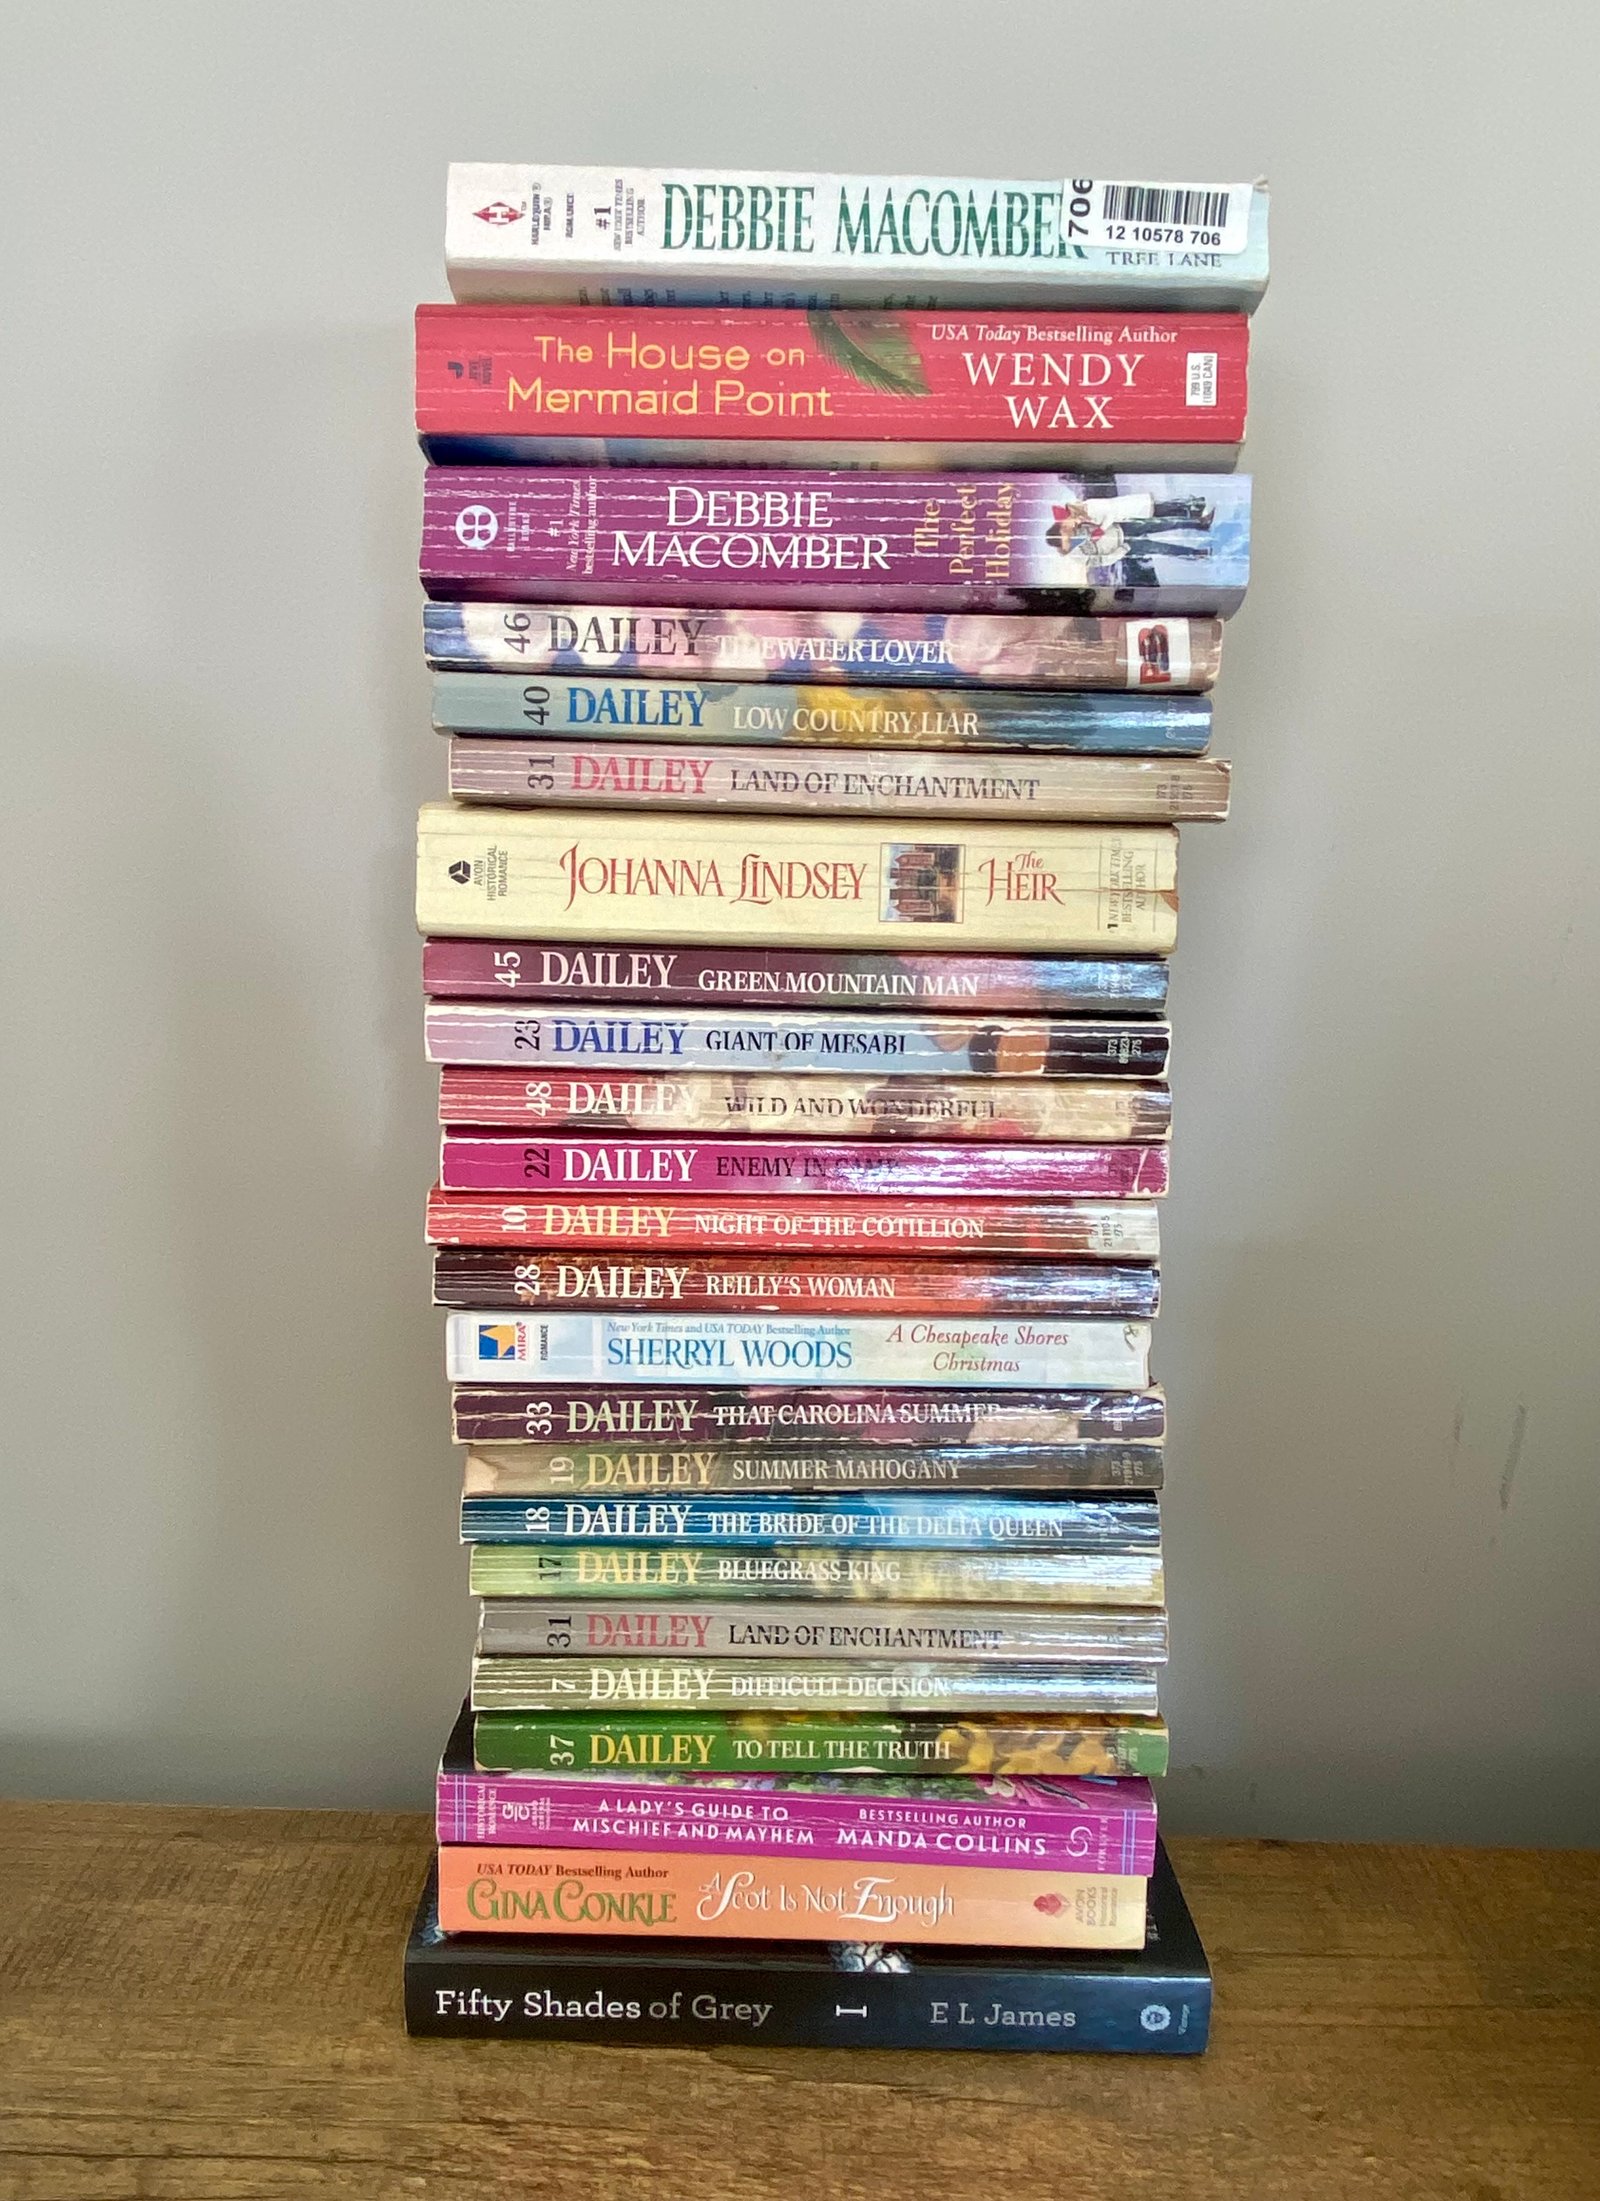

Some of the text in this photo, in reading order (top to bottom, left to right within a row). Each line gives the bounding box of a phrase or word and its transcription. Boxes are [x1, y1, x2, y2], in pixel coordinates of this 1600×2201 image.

[594, 206, 611, 230] #1
[661, 182, 815, 253] DEBBIE
[1066, 179, 1092, 237] 706
[1106, 225, 1221, 247] 12 10578 706
[1106, 251, 1222, 268] TREE LANE
[534, 332, 804, 371] The House on
[931, 324, 1178, 345] USA Today Bestselling Author
[962, 352, 1146, 387] WENDY
[508, 377, 834, 417] Mermaid Point
[1004, 396, 1115, 430] WAX
[666, 486, 834, 528] DEBBIE
[949, 484, 979, 576] Perfect
[985, 482, 1018, 578] Holiday
[611, 531, 892, 571] MACOMBER
[504, 613, 953, 665] 46 DAILEY LOVER
[523, 686, 979, 737] 40 DAILEY LOW COUNTRY LIAR
[528, 754, 1040, 801] 31 DAILEY LAND OF ENCHANTMENT
[474, 860, 483, 886] AVON
[487, 845, 497, 901] HISTORICAL
[498, 851, 508, 897] ROMANCE
[559, 841, 868, 912] JOHANNA LINDSEY
[1016, 850, 1044, 872] The
[978, 859, 1066, 907] HEIR
[494, 950, 980, 997] 45 DAILEY GREEN MOUNTAIN MAN
[513, 1019, 906, 1056] 23 DAILEY GIANT OF MESABI
[525, 1081, 842, 1118] 48 DAILEY WILD AND
[523, 1148, 550, 1179] 22
[562, 1148, 698, 1183] DAILEY
[716, 1156, 795, 1178] ENEMY
[803, 1157, 827, 1178] IN
[502, 1204, 985, 1239] 10 DAILEY NIGHT OF THE COTILLION
[514, 1264, 896, 1299] 28 DAILEY REILLY'S WOMAN
[607, 1321, 851, 1338] New York Times and USA TODAY Bestselling Author
[886, 1324, 1069, 1348] A Chesapeake Shores
[607, 1338, 853, 1371] SHERRYL WOODS
[933, 1352, 1021, 1373] Christmas
[526, 1400, 1001, 1435] 33 DAILEY THAT CAROLINA SUMMER
[550, 1452, 961, 1486] 19 DAILEY SUMMER MAHOGANY
[525, 1503, 1064, 1538] 18 DAILEY THE BRIDE OF THE QUEEN
[538, 1551, 901, 1585] 17 DAILEY BLUEGRASS KING
[546, 1614, 1003, 1650] 31 DAILEY LAND OF ENCHANTMENT
[552, 1667, 949, 1701] 7 DAILEY DIFFICULT DECISION
[550, 1734, 951, 1766] 37 DAILEY TO TELL THE TRUTH
[598, 1799, 789, 1821] A LADY'S GUIDE TO
[858, 1808, 1027, 1830] BESTSELLING AUTHOR
[573, 1818, 814, 1844] MISCHIEF AND MAYHEM
[837, 1828, 1047, 1856] MANDA COLLINS
[477, 1863, 669, 1880] USA TODAY Bestselling Author
[467, 1878, 678, 1927] GINA CONKLE
[696, 1871, 955, 1928] A Scot Is Not Enough
[435, 1988, 774, 2028] Fifty Shades of Grey
[930, 2002, 1077, 2028] E L James
